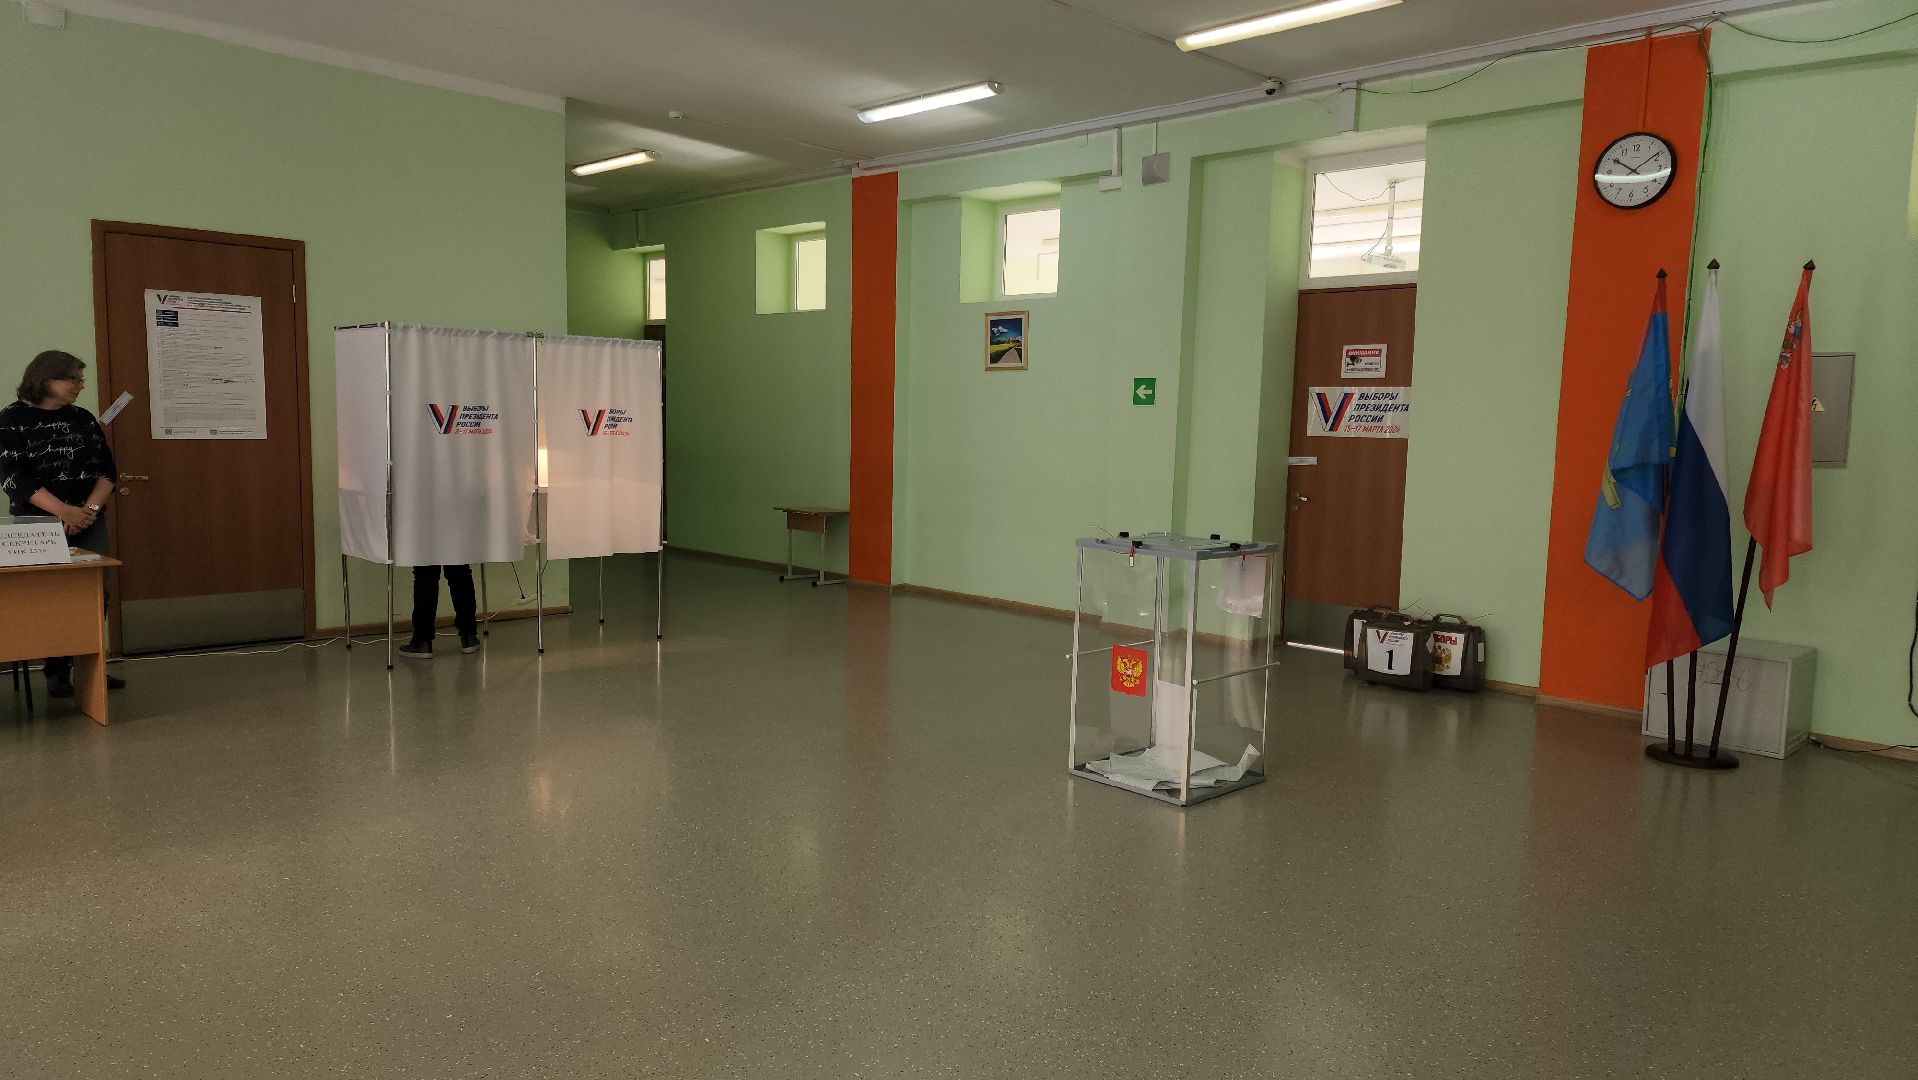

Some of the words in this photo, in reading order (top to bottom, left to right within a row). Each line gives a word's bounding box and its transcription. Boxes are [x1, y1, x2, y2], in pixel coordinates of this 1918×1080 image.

[1621, 148, 1628, 156] 11
[1633, 143, 1641, 152] 12
[1656, 164, 1663, 172] 3
[1616, 187, 1623, 196] 7
[1628, 189, 1634, 198] 6
[1642, 185, 1649, 194] 5
[1357, 392, 1400, 401] ВЫБОРЫ
[1353, 403, 1410, 413] ПРЕЗИДЕНТА
[1347, 414, 1385, 423] РОССИИ
[1361, 425, 1384, 434] МАРТА
[1386, 649, 1394, 671] 1
